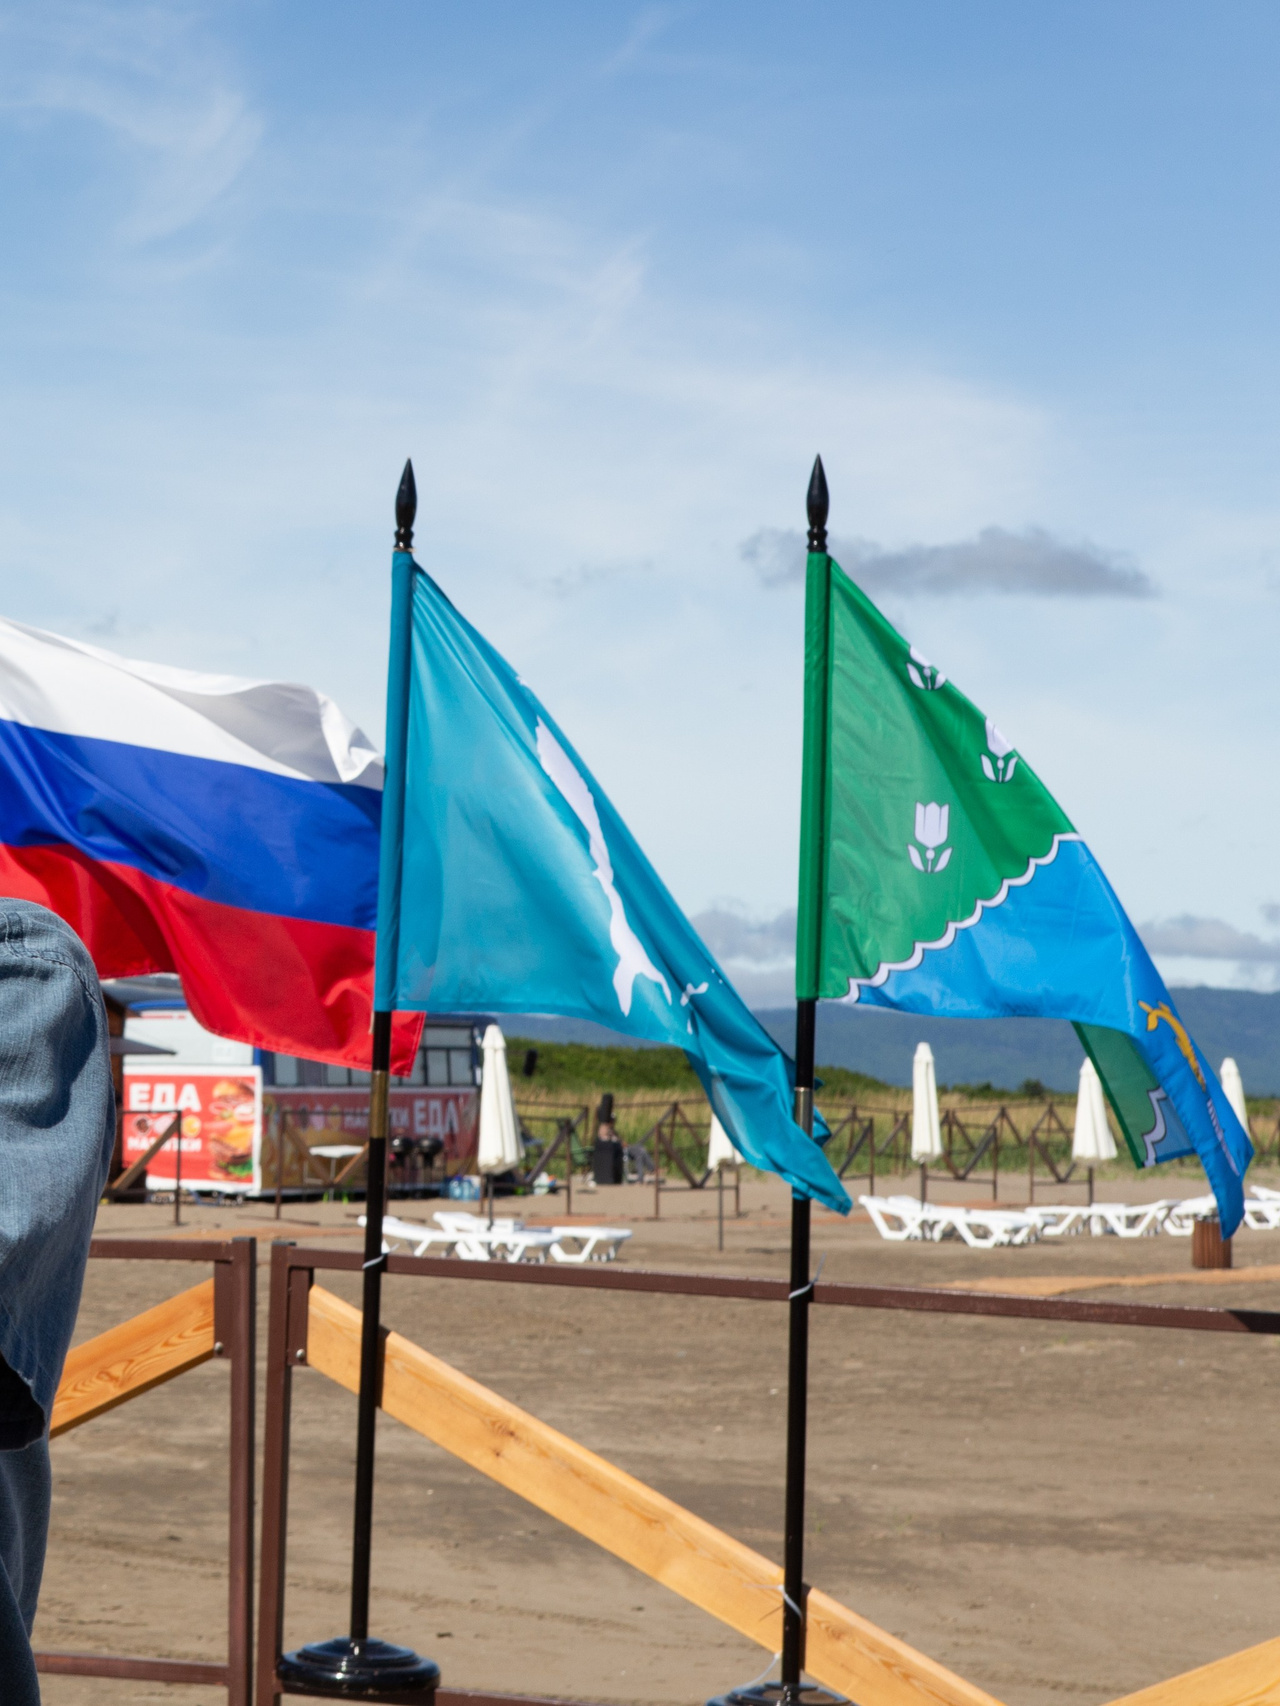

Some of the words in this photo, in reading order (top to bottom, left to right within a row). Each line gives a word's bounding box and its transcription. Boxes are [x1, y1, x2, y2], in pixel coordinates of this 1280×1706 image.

[129, 1083, 202, 1113] ЕДА
[344, 1107, 409, 1128] НАПКИ
[414, 1099, 459, 1137] ЕДА
